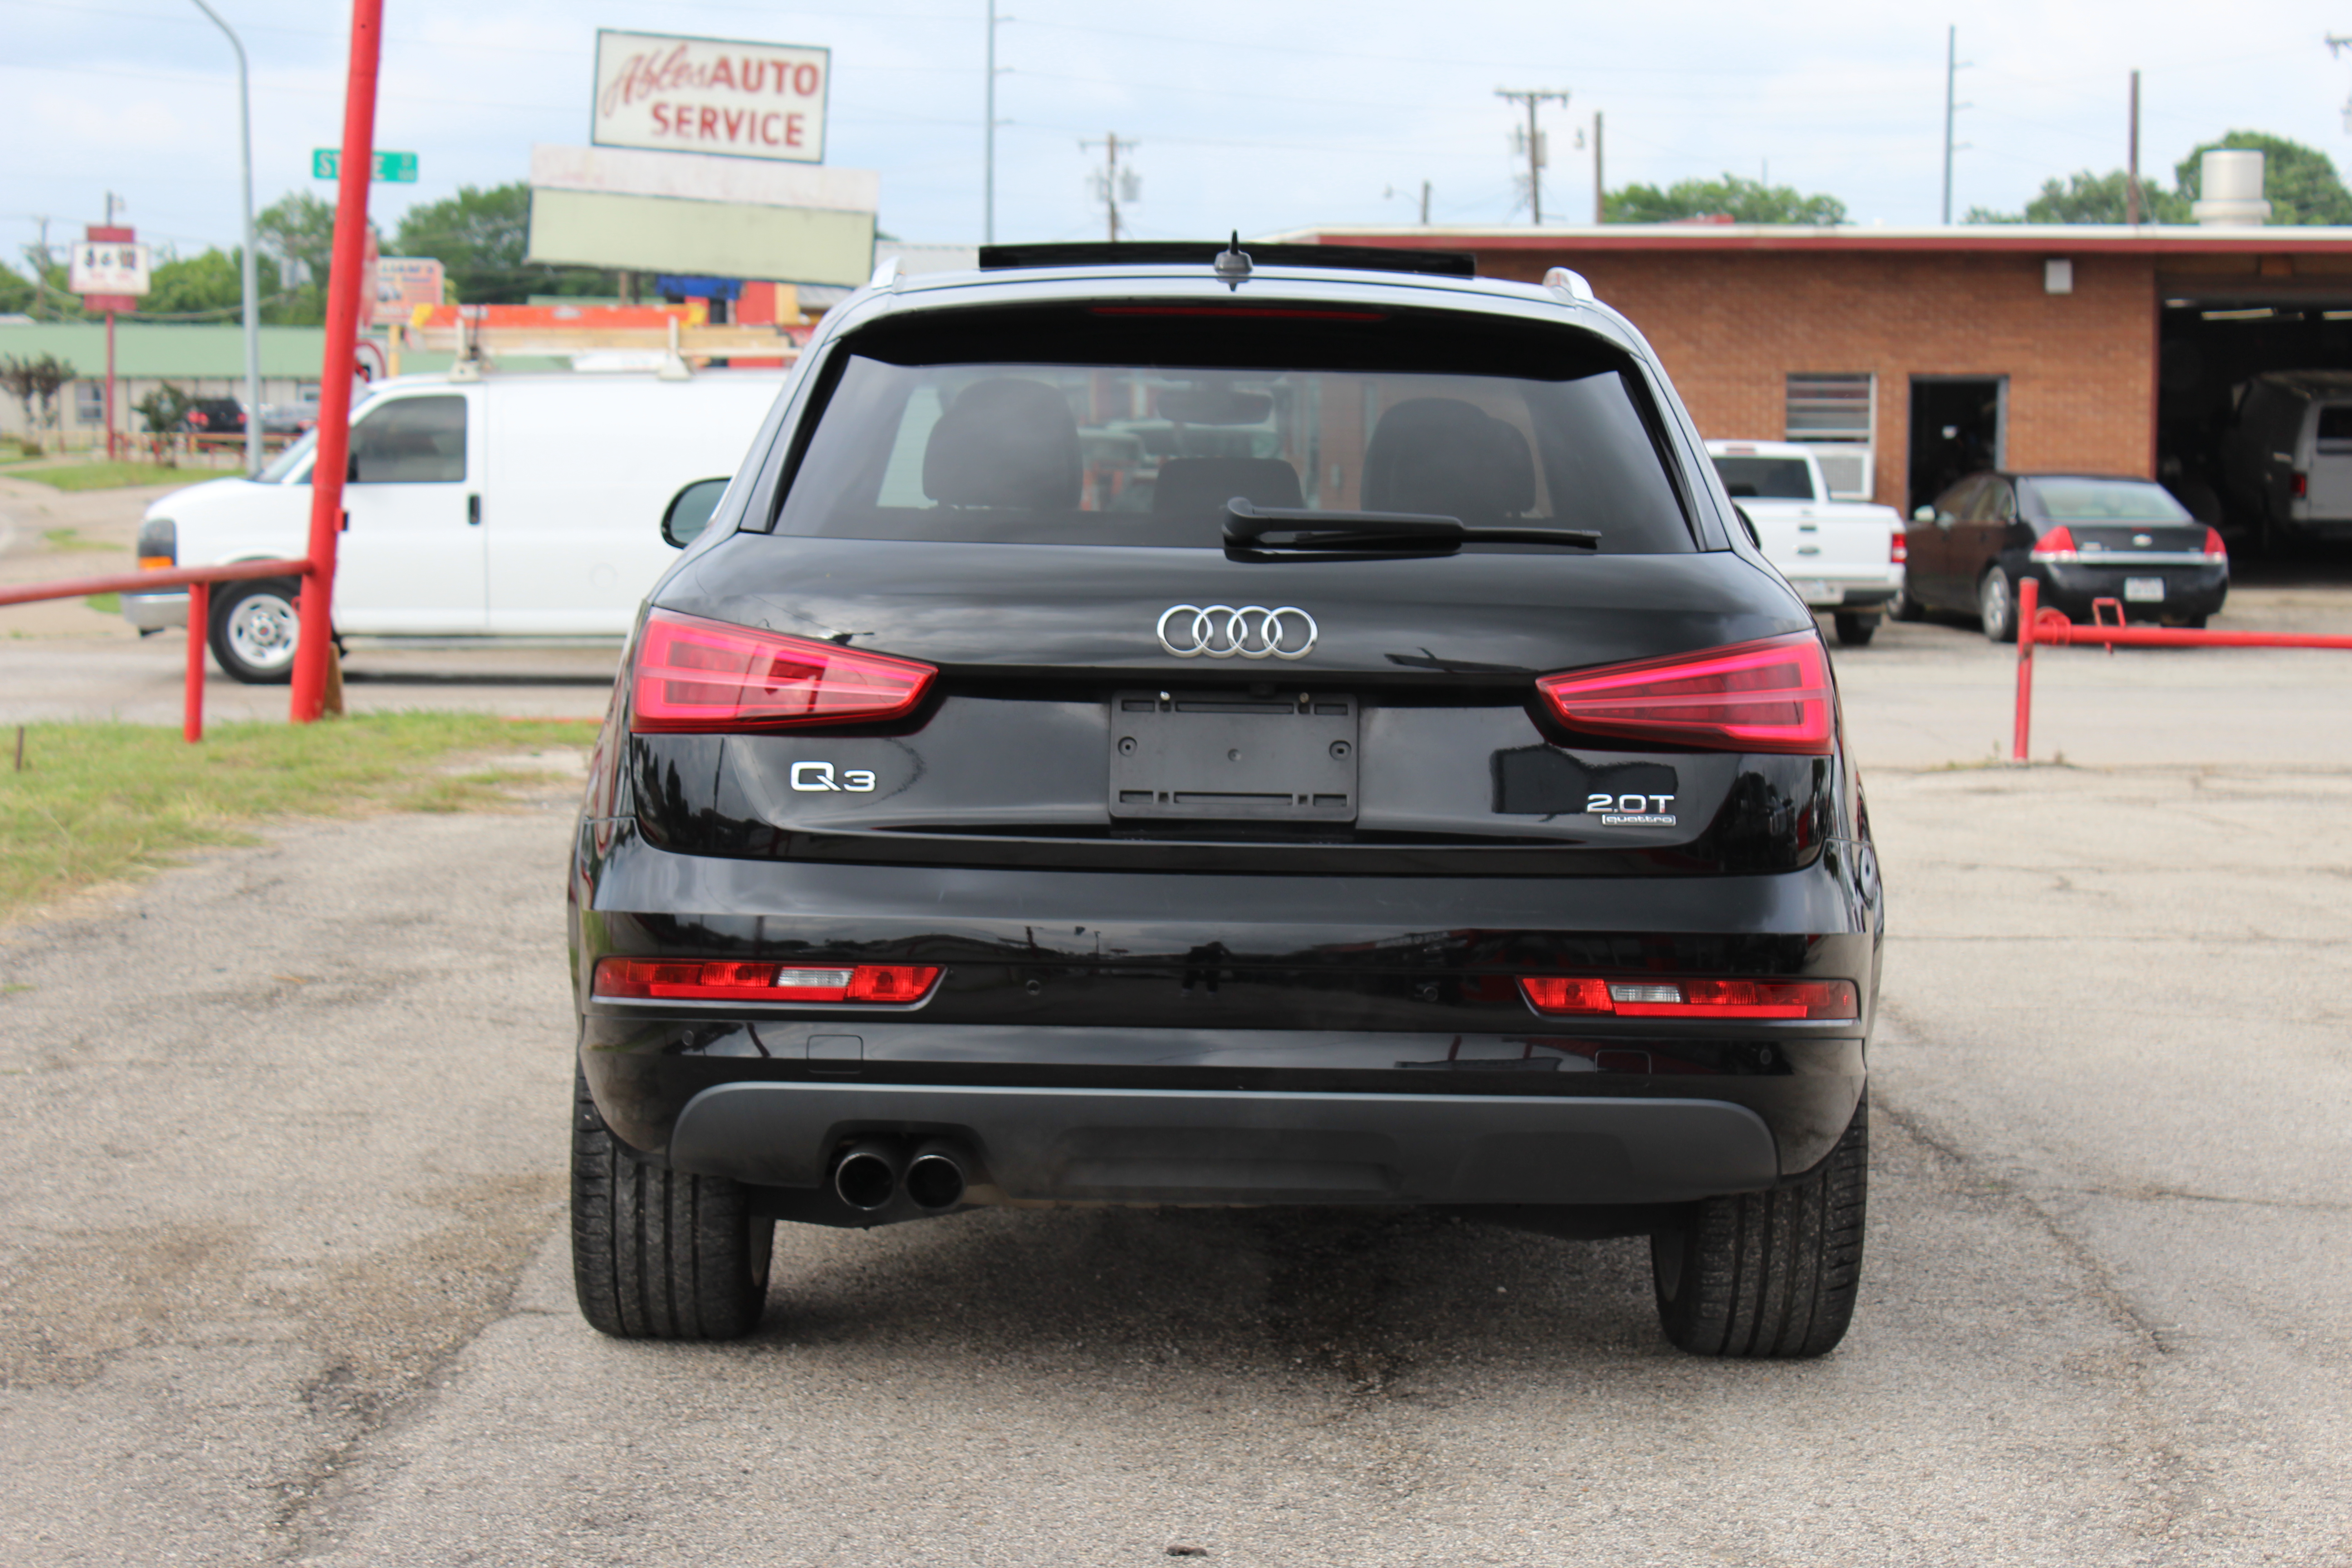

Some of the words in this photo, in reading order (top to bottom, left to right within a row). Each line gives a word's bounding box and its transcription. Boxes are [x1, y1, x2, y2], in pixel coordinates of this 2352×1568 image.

[710, 56, 820, 97] AUTO
[651, 101, 804, 147] SERVICE
[318, 152, 385, 179] STE
[790, 760, 876, 792] Q3
[1587, 794, 1675, 813] 2.0T
[1606, 815, 1673, 825] quattro
